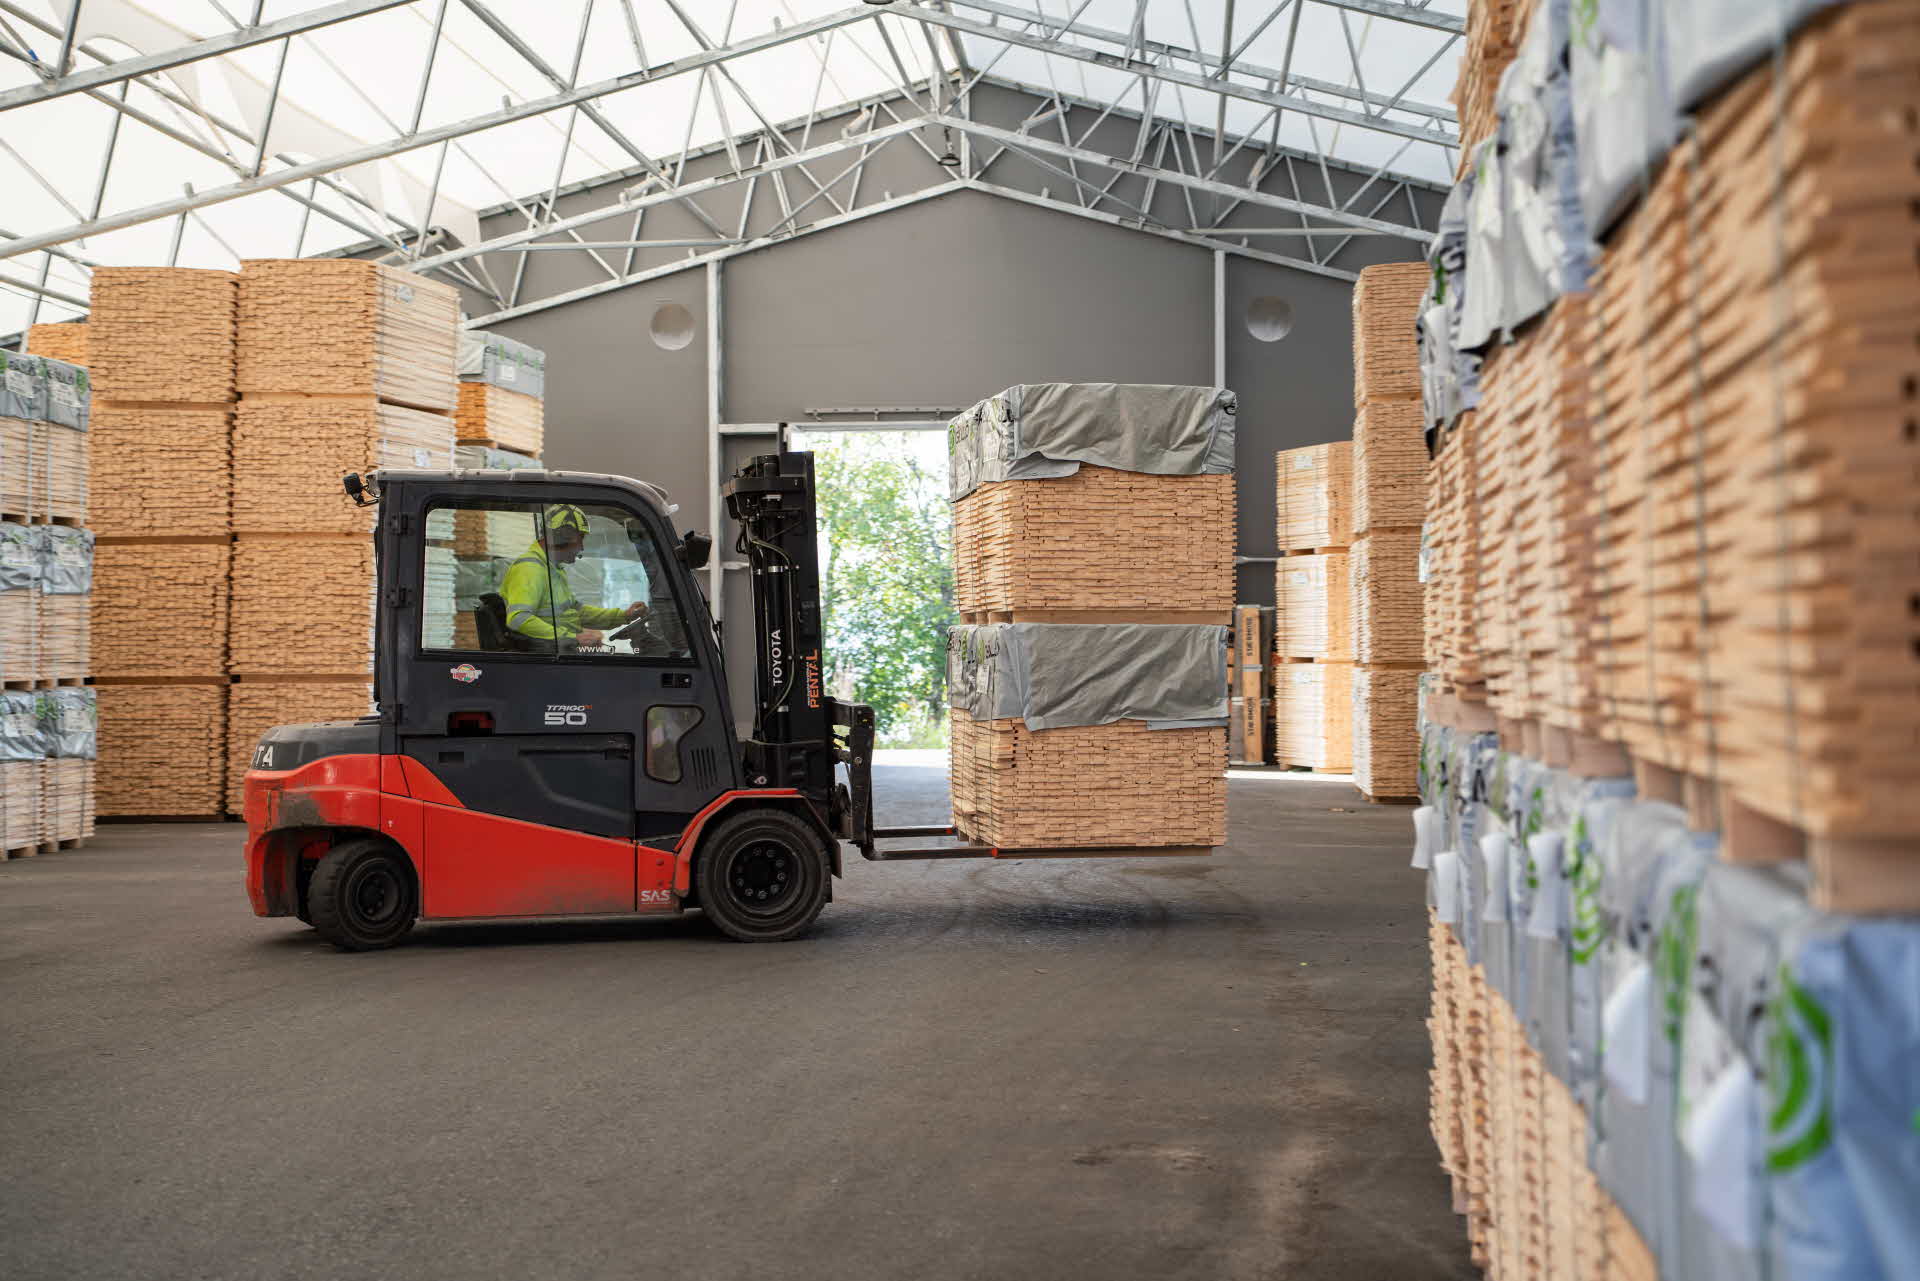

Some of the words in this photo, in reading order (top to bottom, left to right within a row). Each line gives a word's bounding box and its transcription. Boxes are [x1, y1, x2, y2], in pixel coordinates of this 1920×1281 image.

[771, 629, 783, 687] TOYOTA
[544, 711, 587, 726] 50
[640, 889, 671, 902] SAS
